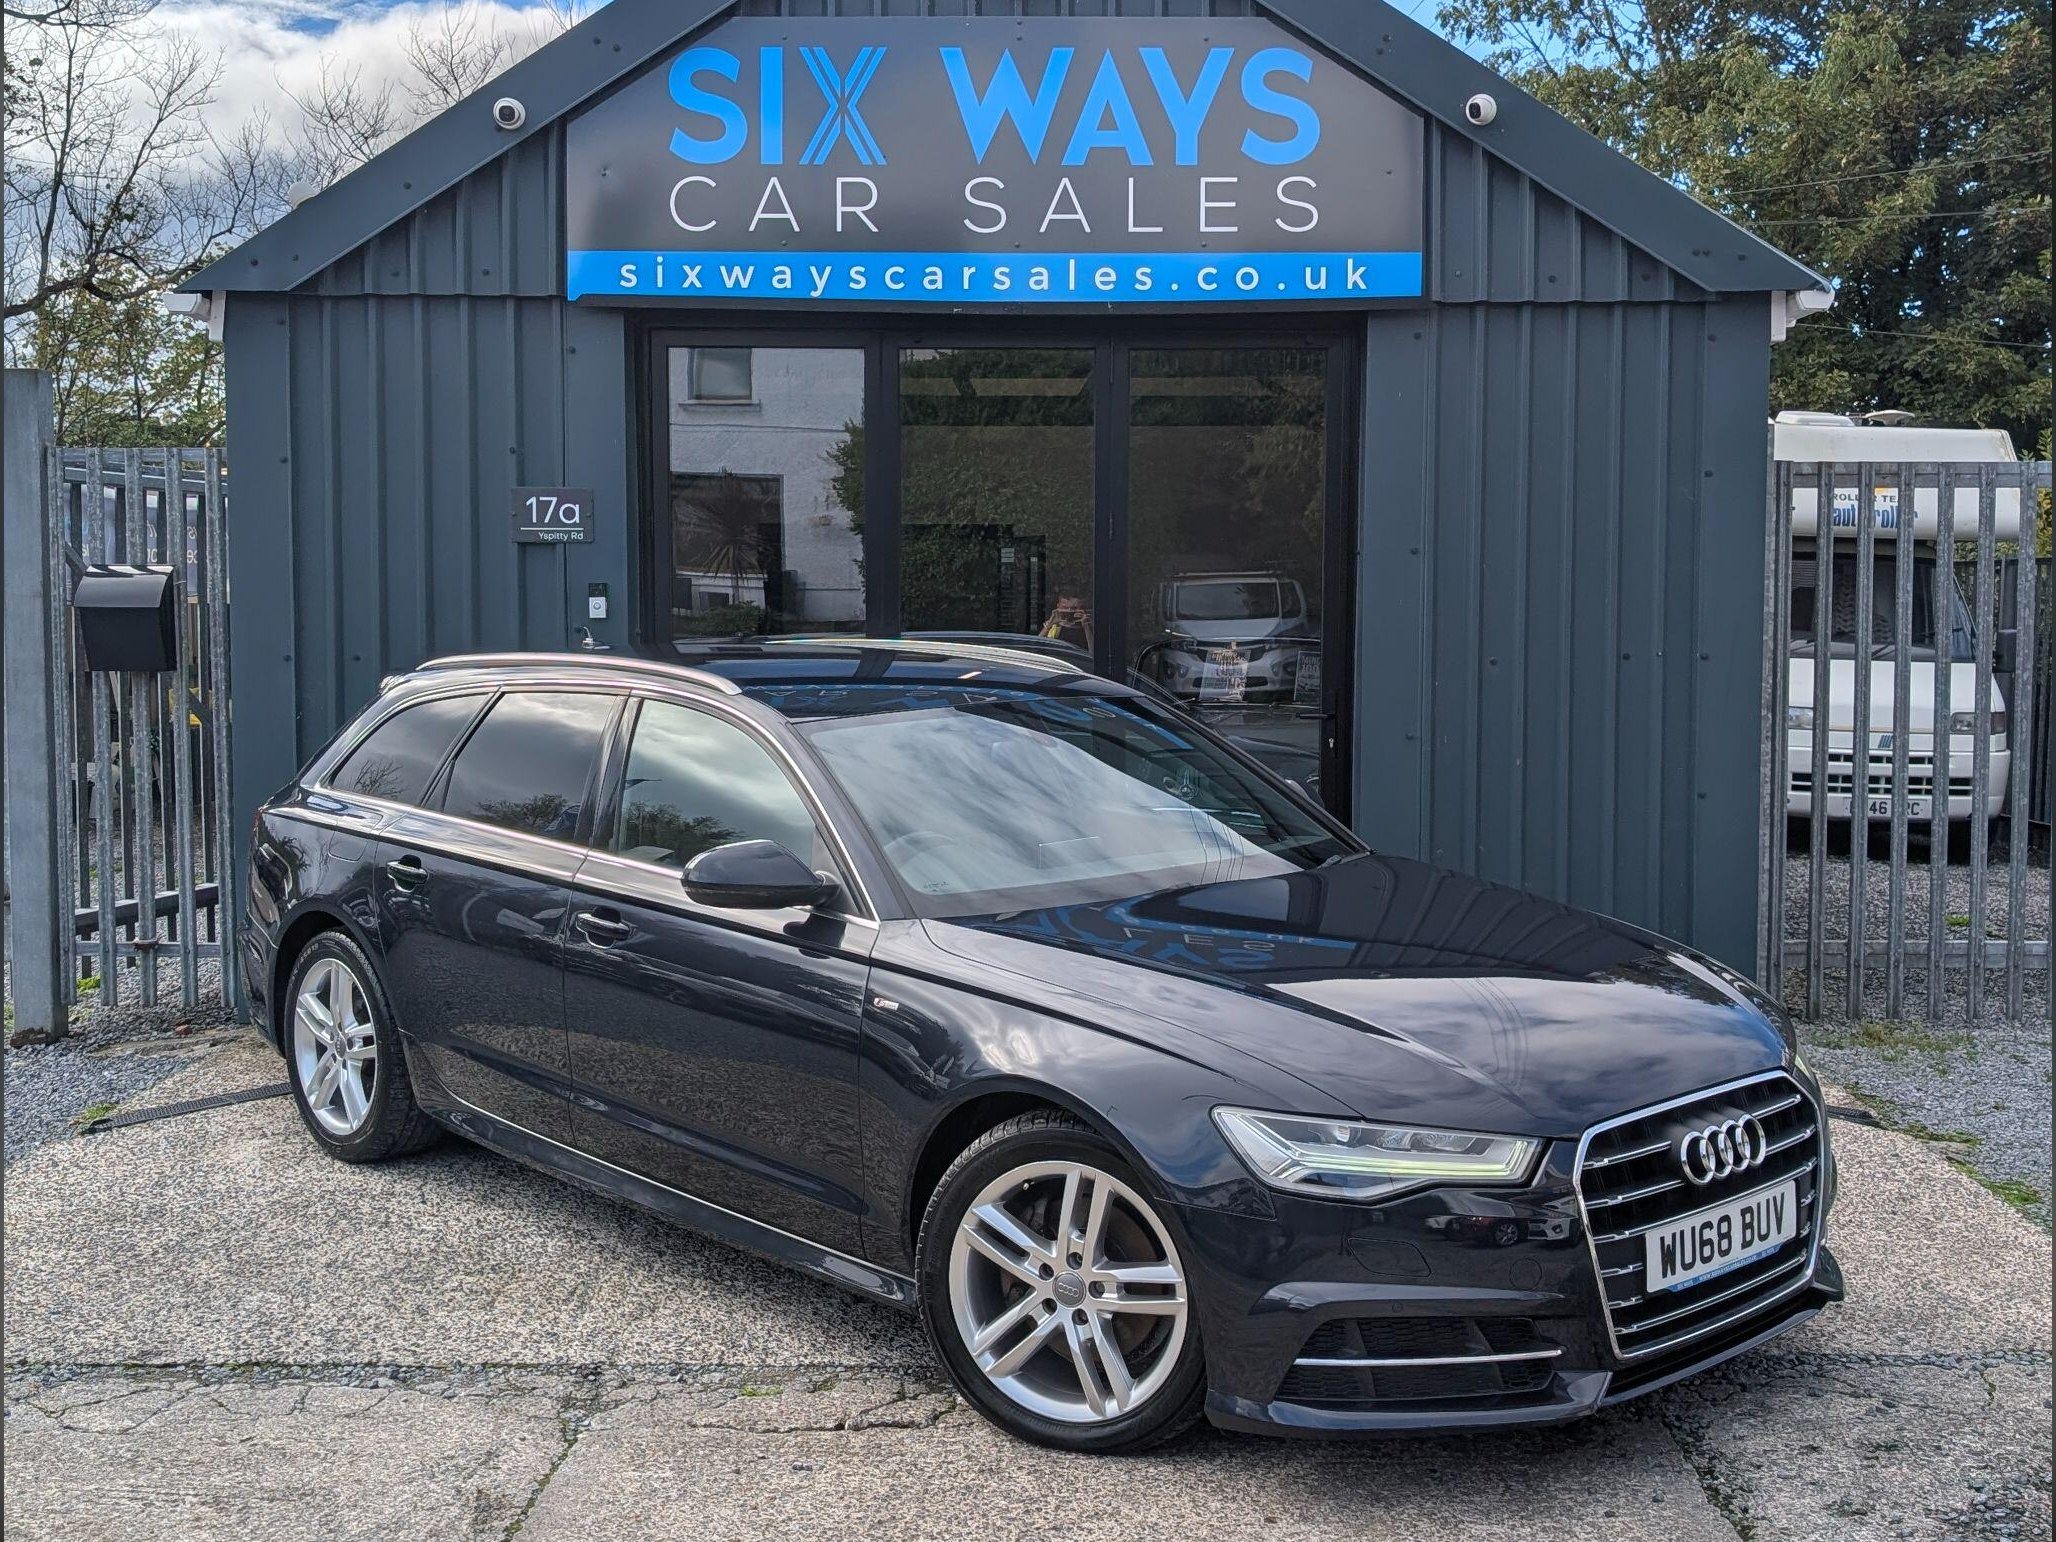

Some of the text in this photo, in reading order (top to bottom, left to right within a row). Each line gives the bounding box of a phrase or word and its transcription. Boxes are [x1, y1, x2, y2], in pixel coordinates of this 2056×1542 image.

[668, 47, 1321, 166] SIX WAYS
[670, 177, 1321, 234] CAR SALES
[619, 255, 1367, 298] sixwayscarsales.co.uk
[525, 496, 580, 524] 17a
[538, 532, 584, 541] Yspitty Rd
[1660, 1214, 1733, 1279] WU68
[1740, 1192, 1786, 1250] BUV
